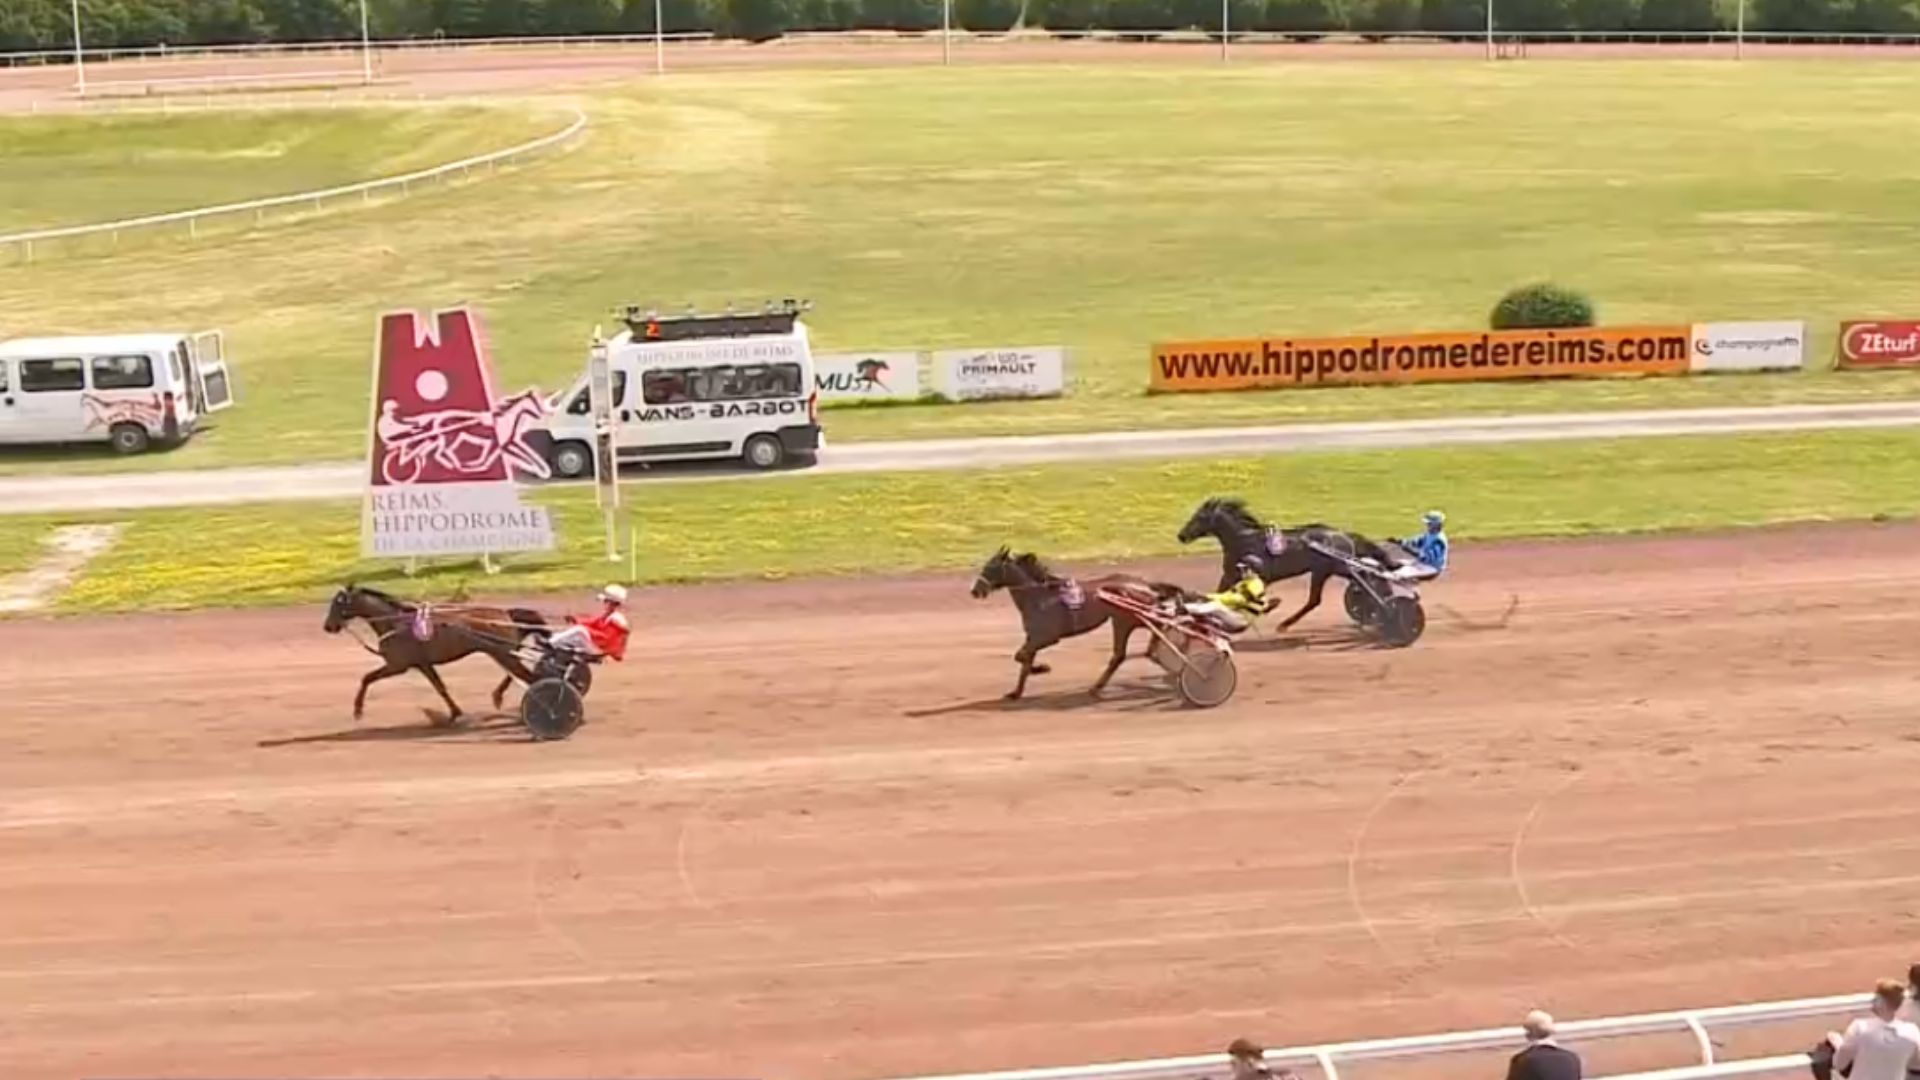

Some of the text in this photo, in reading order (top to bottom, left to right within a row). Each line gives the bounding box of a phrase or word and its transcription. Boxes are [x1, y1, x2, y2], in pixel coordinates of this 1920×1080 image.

[1861, 333, 1917, 353] ZEturf
[1158, 334, 1687, 380] www.hippodromedereims.com
[962, 362, 1035, 375] PRIMAULT
[372, 511, 541, 533] HIPPODROME
